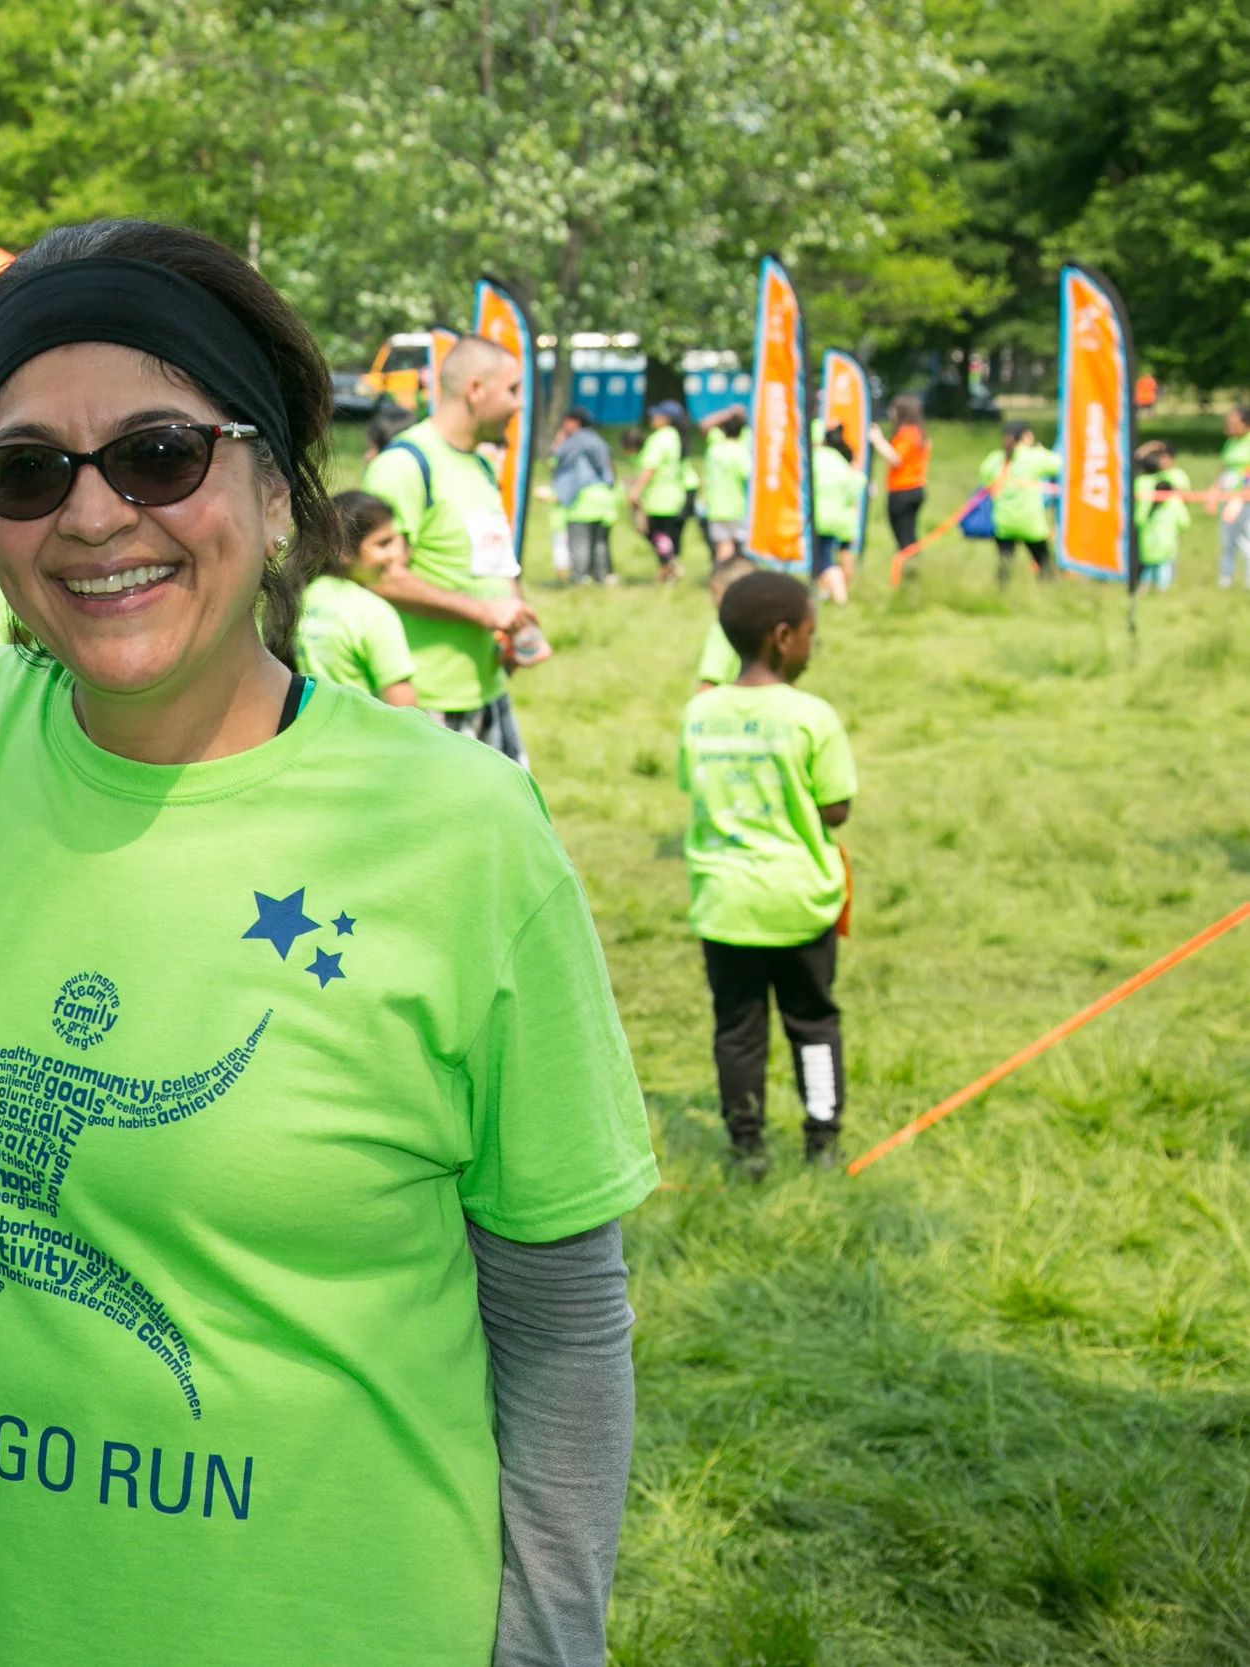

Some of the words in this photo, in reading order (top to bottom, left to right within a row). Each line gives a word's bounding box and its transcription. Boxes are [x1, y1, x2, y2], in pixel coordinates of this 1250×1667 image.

[60, 972, 89, 995] youth
[69, 985, 106, 1003] team
[90, 971, 120, 1009] inspire
[53, 995, 118, 1032] family
[67, 1020, 90, 1036] grit
[52, 1017, 104, 1051] strength
[19, 1065, 46, 1083] run
[41, 1056, 155, 1104] community
[157, 1047, 255, 1125] achievement
[161, 1047, 242, 1093] celebration
[43, 1075, 106, 1116] goals
[105, 1093, 163, 1116] excellence
[88, 1115, 115, 1128] good
[118, 1116, 157, 1129] habits
[47, 1105, 87, 1208] powerful
[70, 1261, 101, 1290] mile
[74, 1238, 131, 1283] unity
[68, 1289, 136, 1331] exercise
[103, 1290, 141, 1320] fitness
[107, 1279, 168, 1336] perseverance
[131, 1281, 192, 1368] endurance
[137, 1322, 201, 1421] commitment
[100, 1440, 253, 1520] RUN
